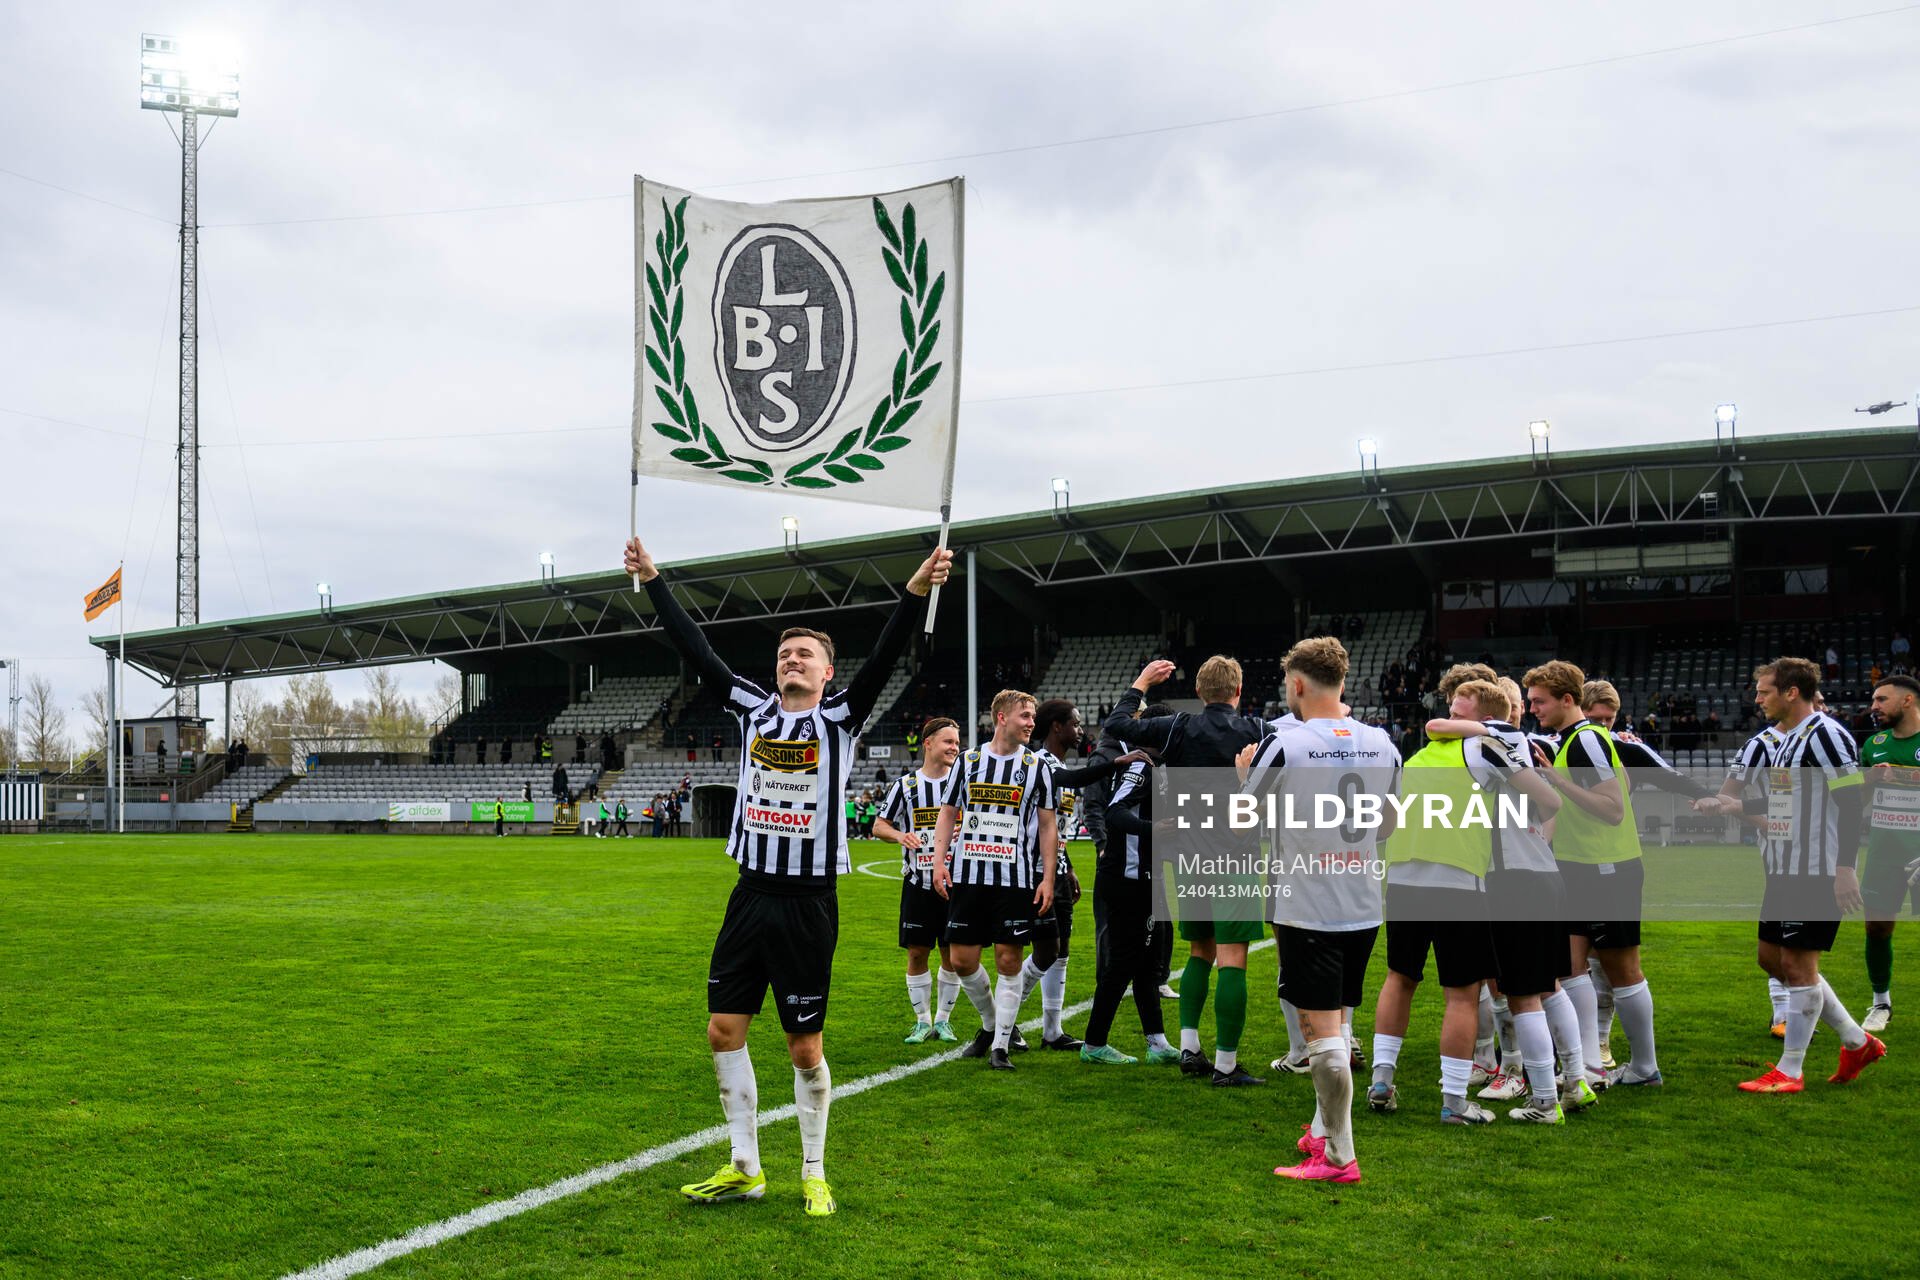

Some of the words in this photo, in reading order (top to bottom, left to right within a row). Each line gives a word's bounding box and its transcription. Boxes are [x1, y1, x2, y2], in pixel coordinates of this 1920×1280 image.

[759, 245, 809, 306] L
[758, 371, 800, 435] S
[1309, 750, 1379, 760] Kundpartner
[765, 781, 811, 792] NÄTVERKET
[971, 788, 1013, 800] OHLSSONS
[408, 803, 443, 816] alfdex
[747, 806, 813, 826] FLYTGOLV
[915, 812, 939, 822] OHLSS
[749, 820, 797, 834] LANDSKRONA
[982, 819, 1014, 829] NÄTVERKET
[965, 843, 1014, 855] FLYTGOLV
[968, 852, 1003, 860] LANDSKRONA
